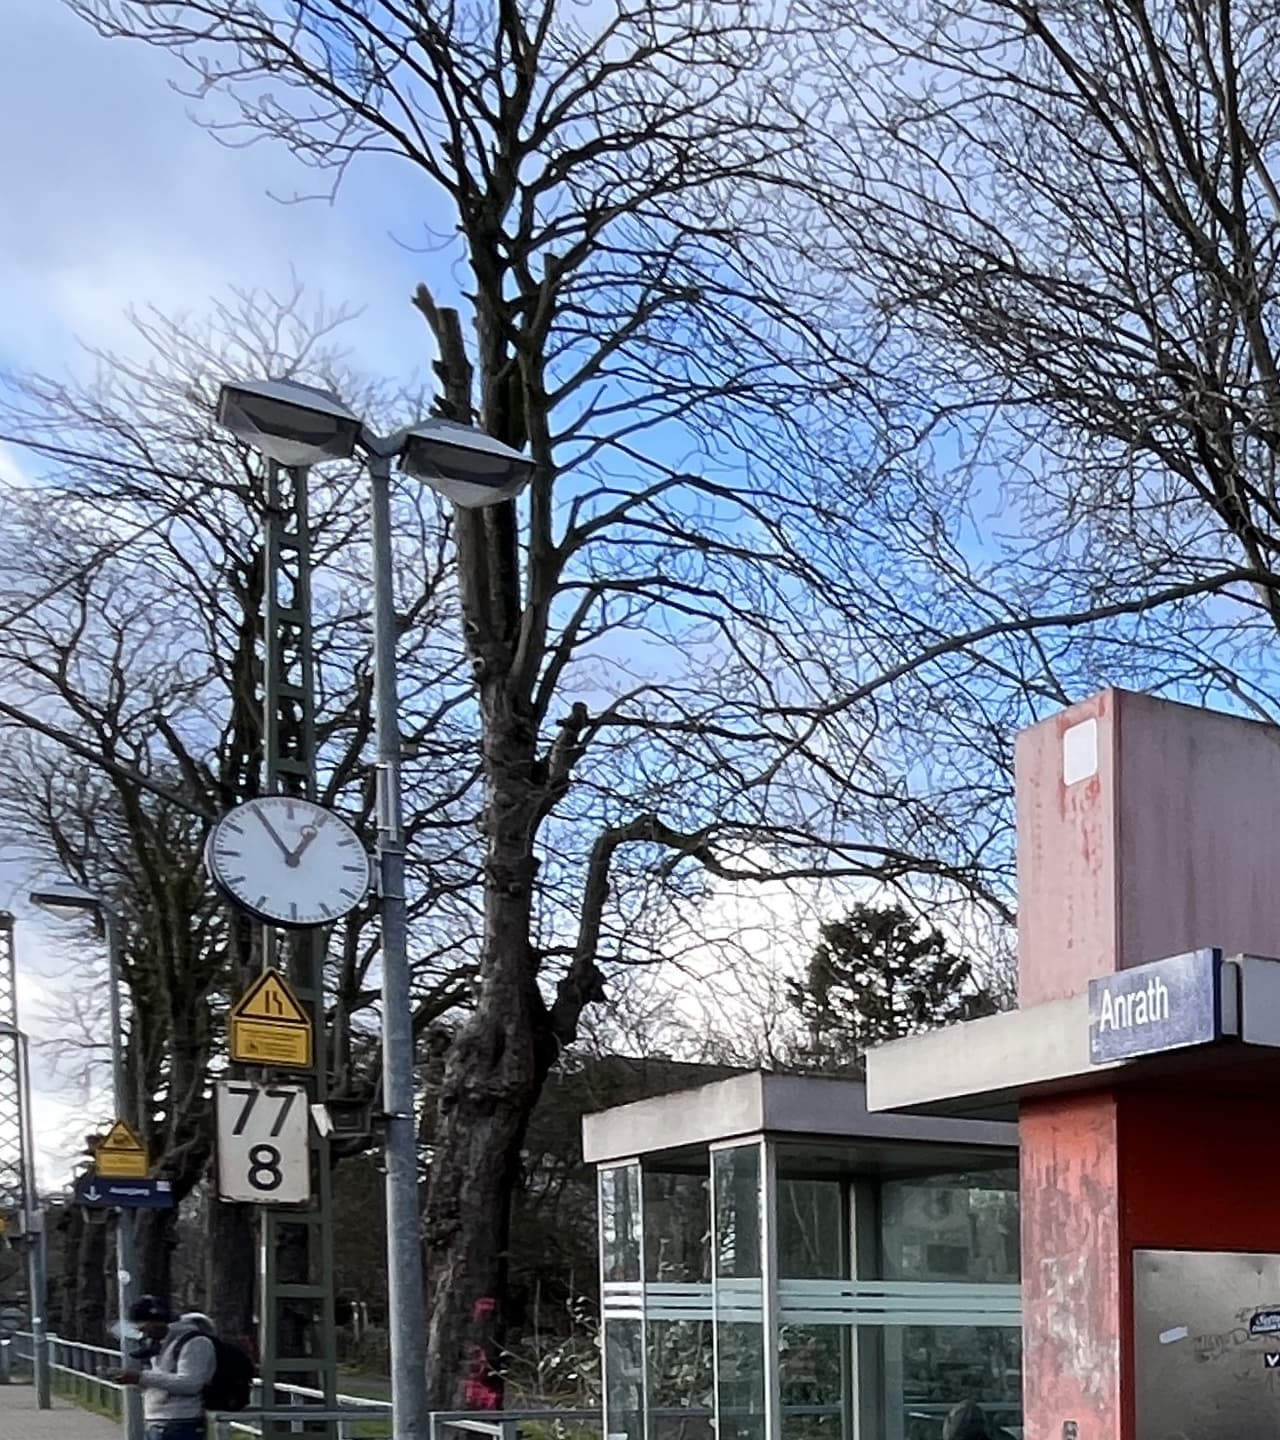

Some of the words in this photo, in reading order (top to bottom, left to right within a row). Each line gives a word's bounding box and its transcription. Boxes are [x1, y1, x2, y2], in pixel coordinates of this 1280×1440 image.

[1099, 976, 1169, 1032] Anrath
[228, 1087, 297, 1137] 77
[247, 1143, 283, 1191] 8
